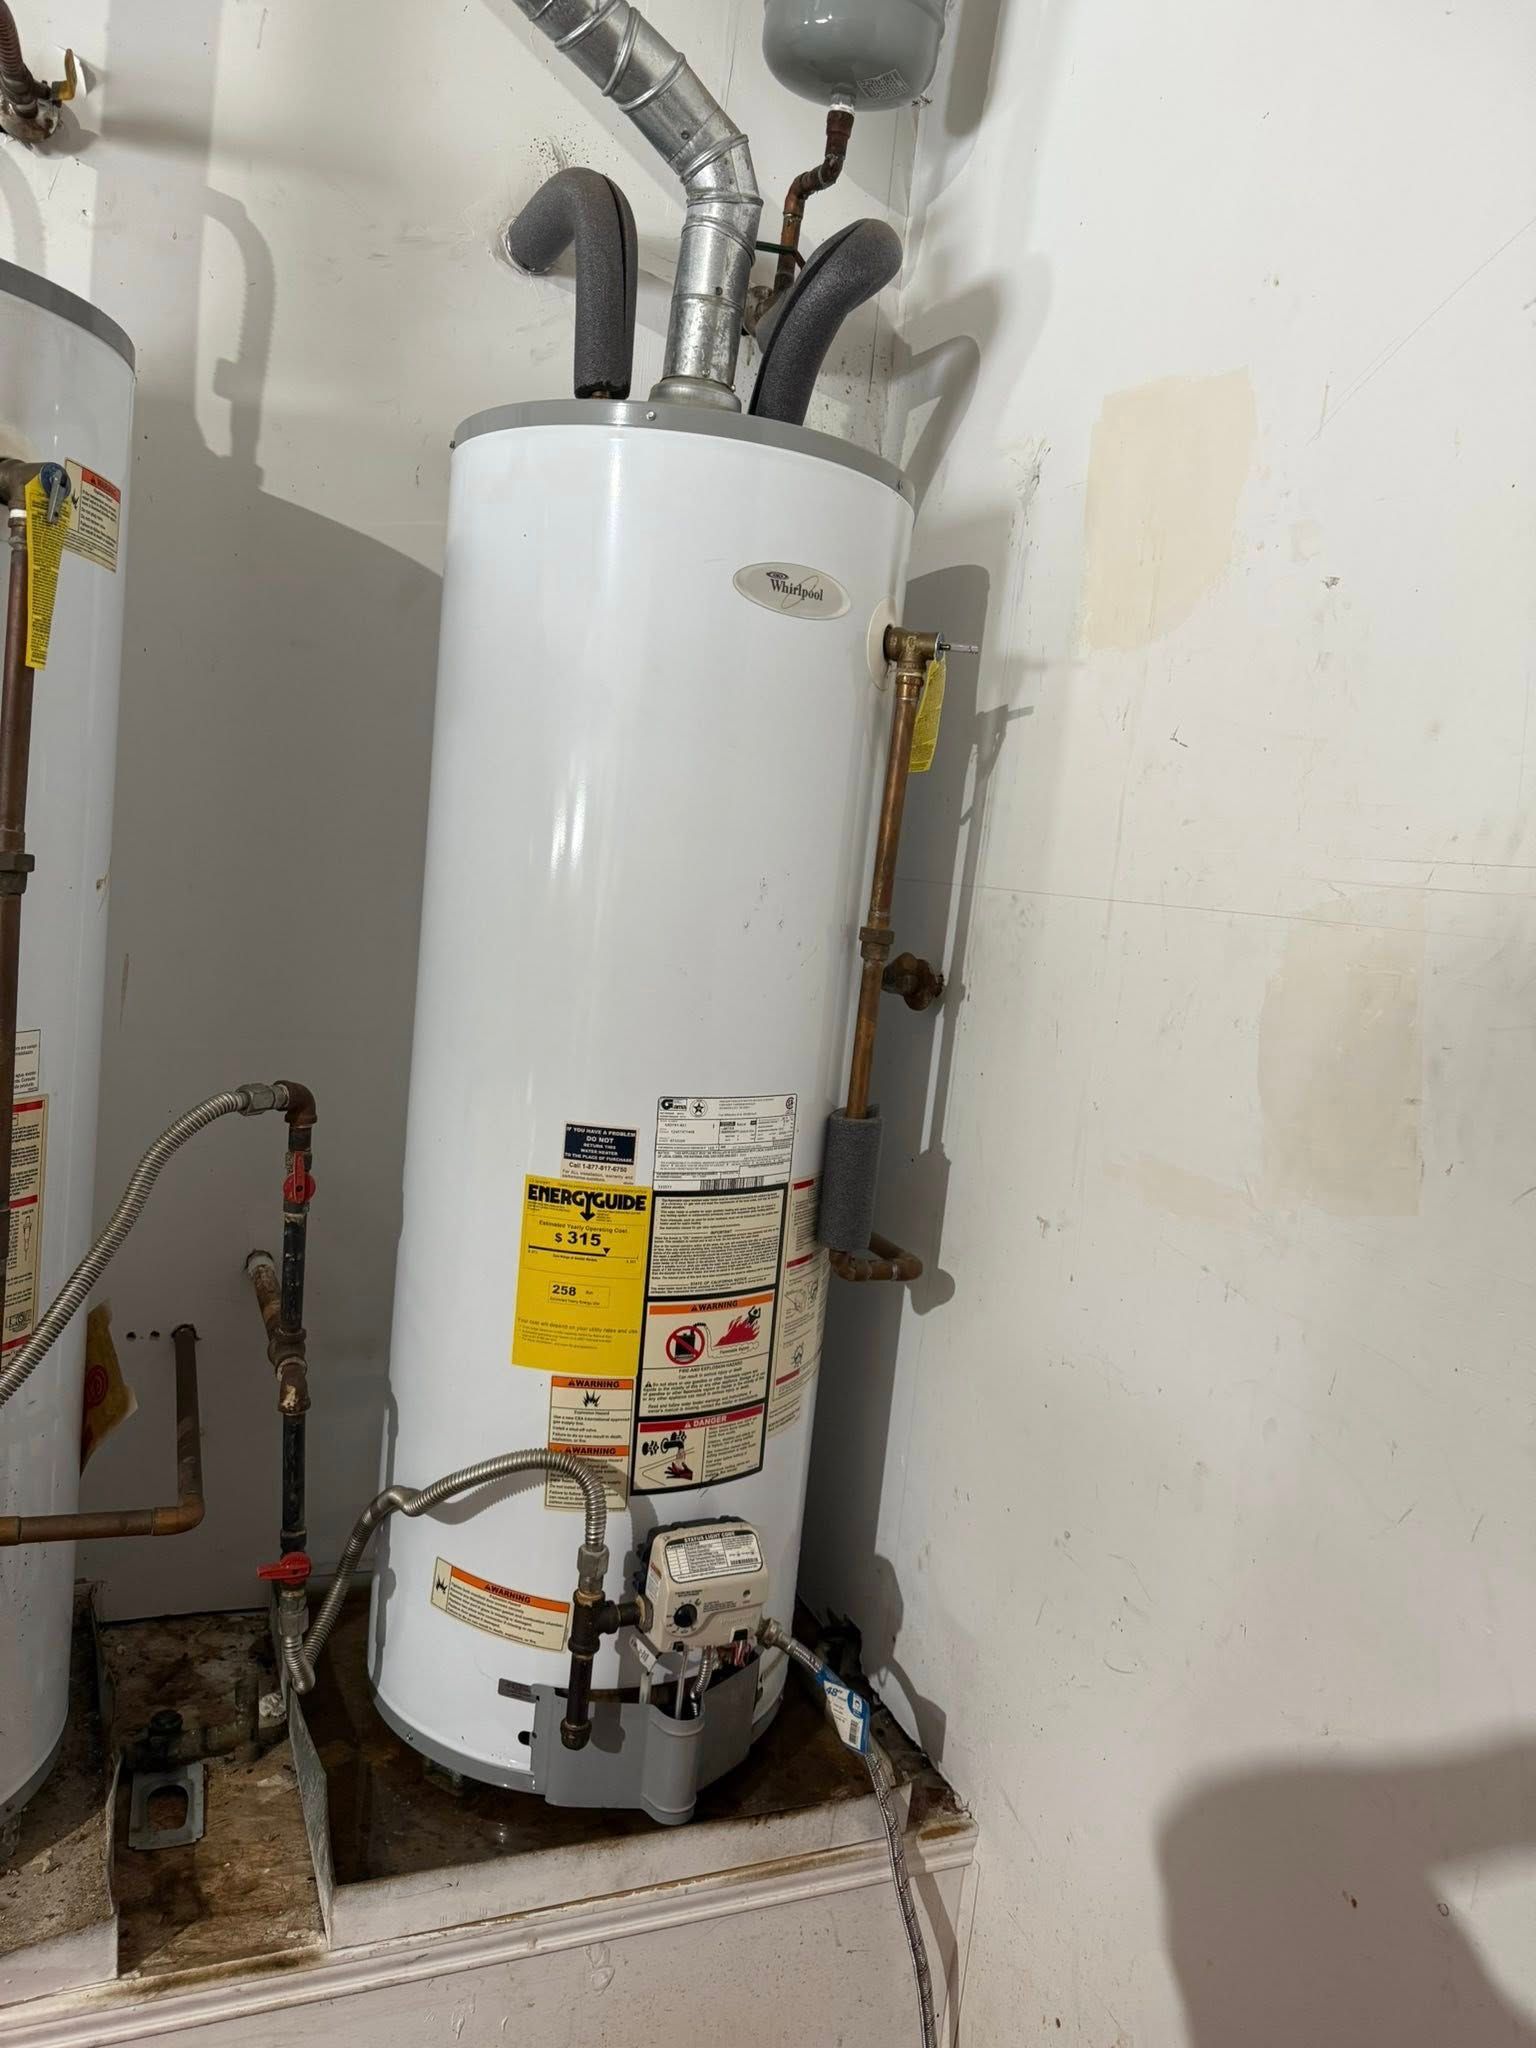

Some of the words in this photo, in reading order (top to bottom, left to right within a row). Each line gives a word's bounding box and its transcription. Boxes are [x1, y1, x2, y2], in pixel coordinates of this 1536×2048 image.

[770, 578, 823, 601] Whirlpool
[528, 1184, 647, 1214] ENERGYGUIDE
[539, 1220, 566, 1229] Estimated
[585, 1225, 613, 1234] Operating
[555, 1233, 563, 1243] $
[567, 1231, 601, 1247] 315
[552, 1285, 577, 1296] 258
[699, 1300, 738, 1312] WARNING
[550, 1322, 568, 1330] depend
[576, 1380, 620, 1388] WARNING
[693, 1416, 727, 1427] DANGER
[572, 1447, 616, 1455] WARNING
[490, 1585, 531, 1604] WARNING
